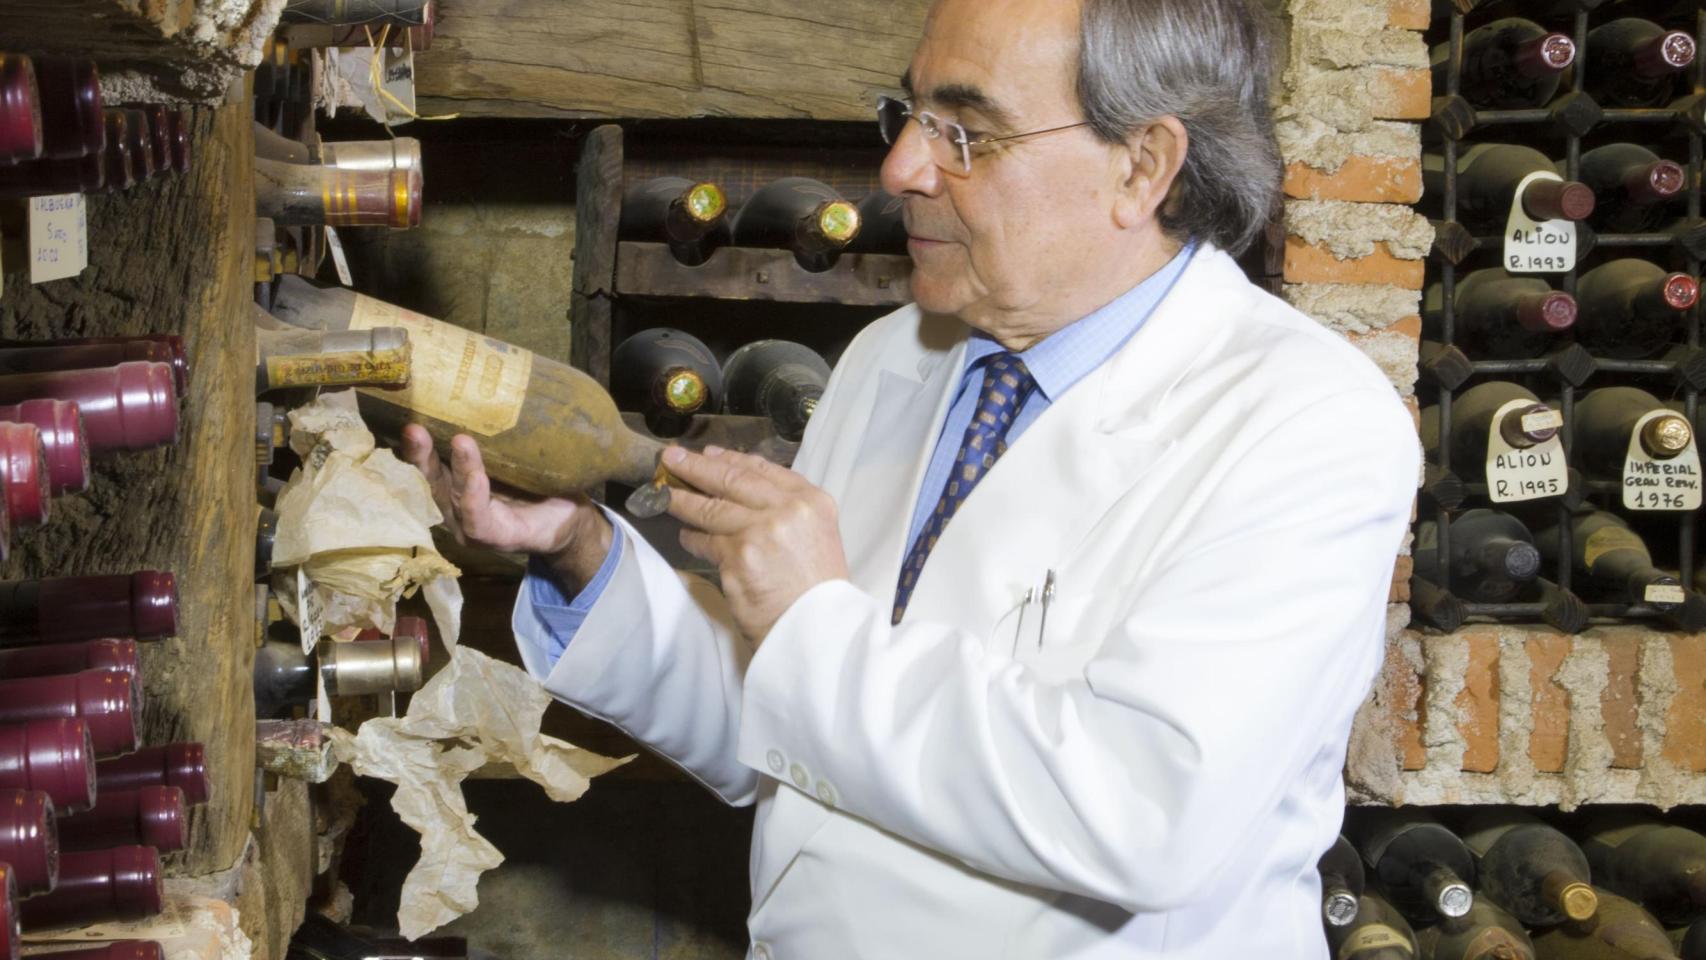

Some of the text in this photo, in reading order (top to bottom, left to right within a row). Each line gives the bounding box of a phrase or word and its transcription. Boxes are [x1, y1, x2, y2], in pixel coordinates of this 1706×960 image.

[1510, 255, 1565, 269] R. 1993
[1630, 461, 1697, 475] IMPERIAL
[1496, 479, 1558, 497] R. 1995
[1624, 476, 1660, 488] GRAN
[1634, 491, 1685, 508] 1976
